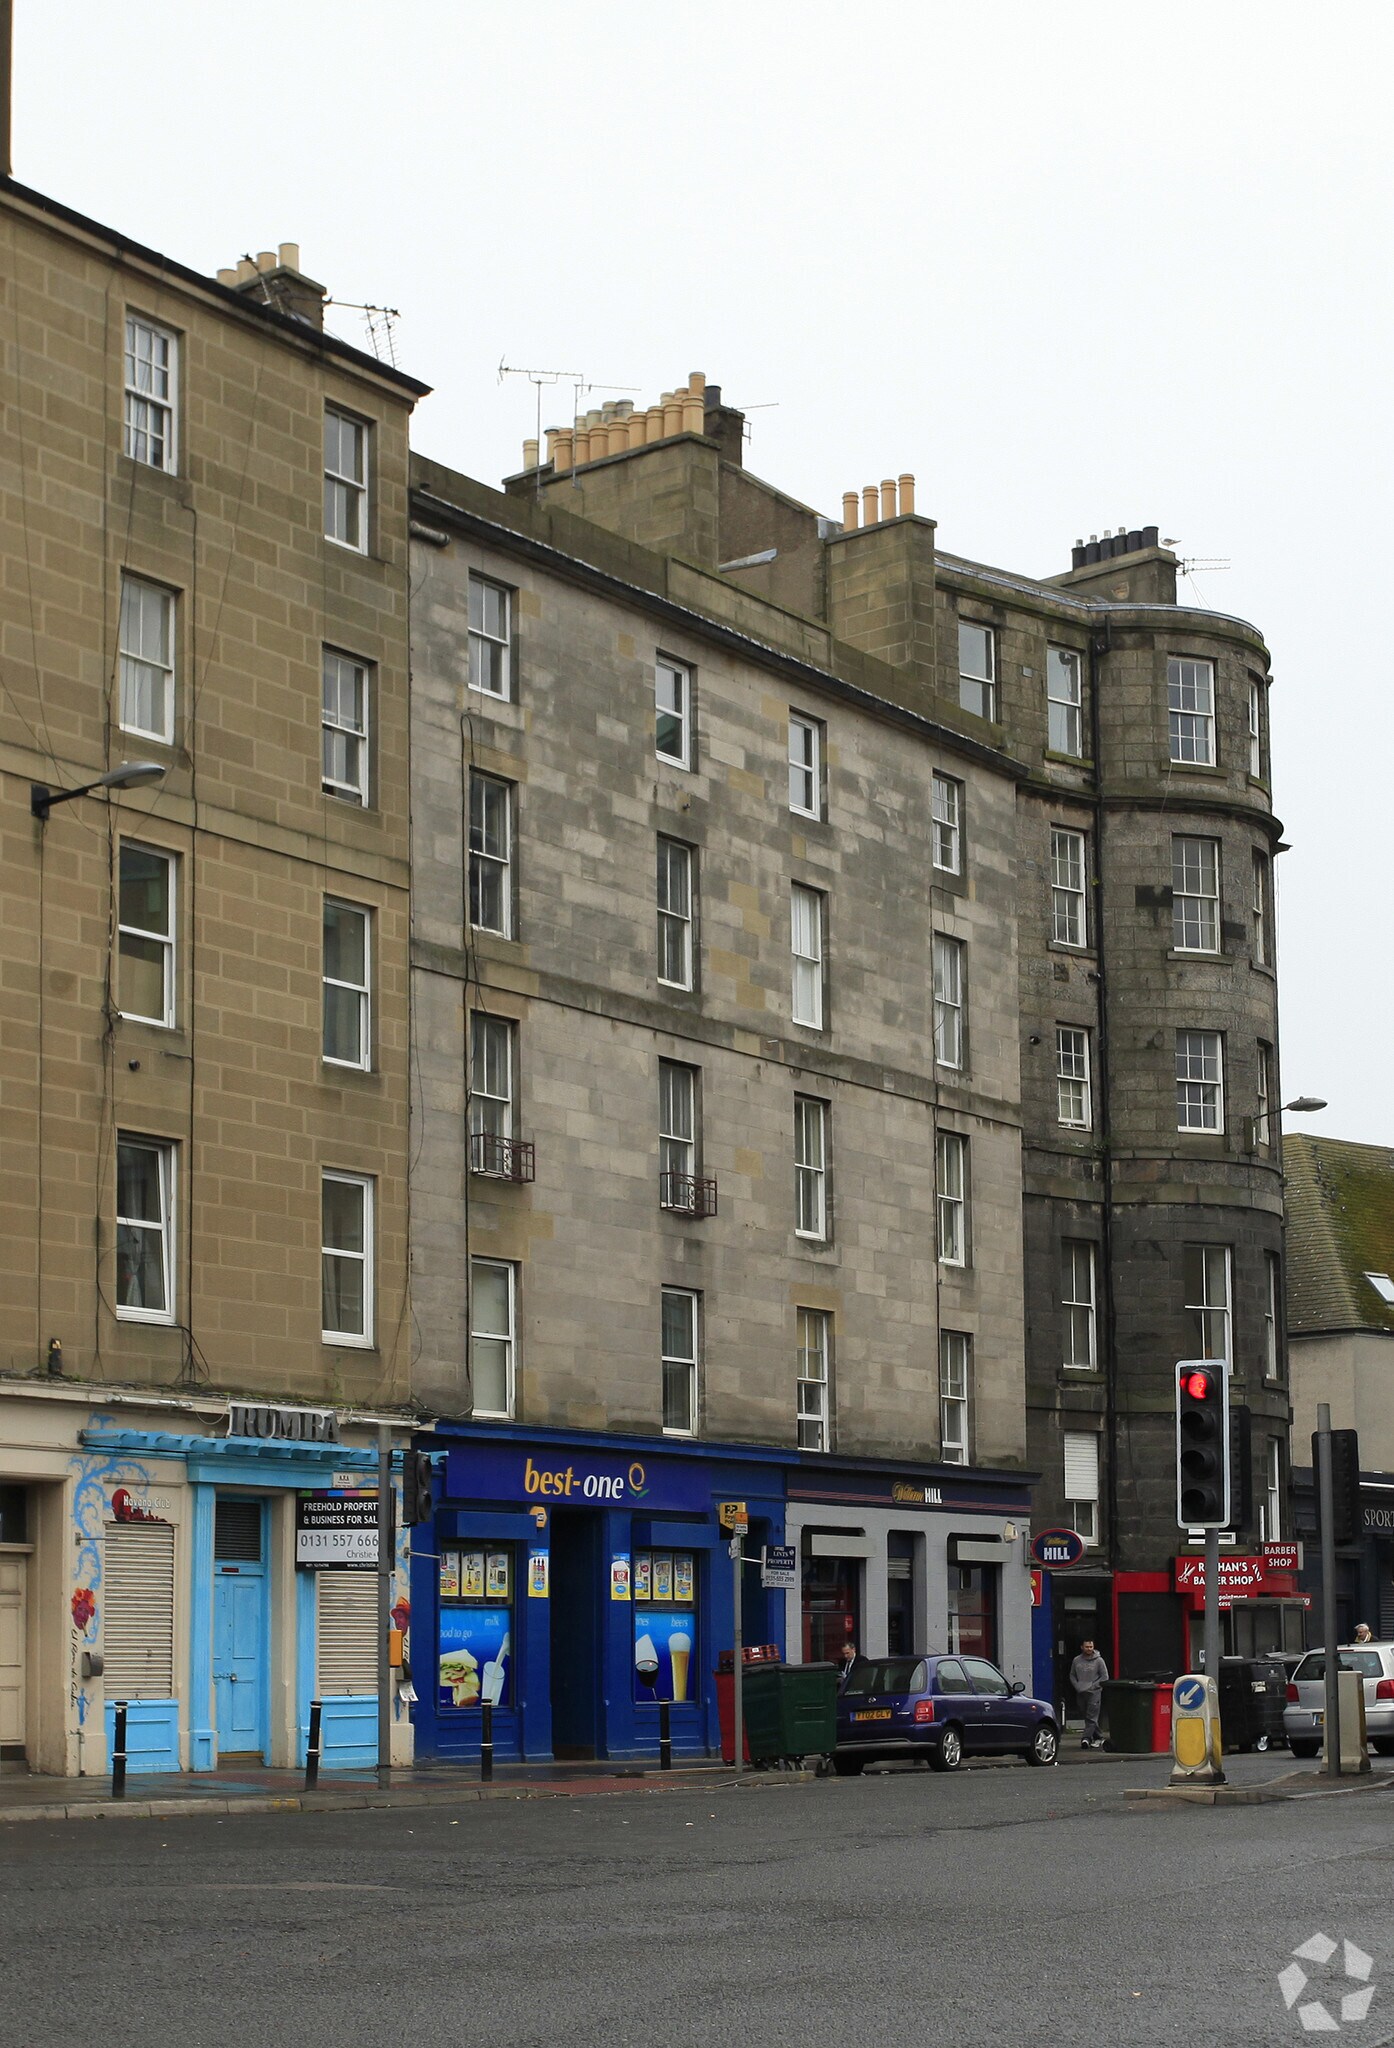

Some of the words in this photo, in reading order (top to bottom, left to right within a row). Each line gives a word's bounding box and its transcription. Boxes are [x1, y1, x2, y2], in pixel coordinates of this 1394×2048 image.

[231, 1406, 341, 1442] RUMBA
[924, 1487, 943, 1504] HILL
[123, 1495, 152, 1507] Havana
[303, 1502, 342, 1512] FREEHOLD
[343, 1502, 380, 1511] PROPERT
[303, 1516, 310, 1525] &
[311, 1516, 345, 1525] BUSINESS
[346, 1516, 362, 1524] FOR
[363, 1515, 379, 1524] SAL
[300, 1534, 328, 1547] 0131
[332, 1534, 353, 1547] 557
[357, 1534, 379, 1547] 666
[346, 1550, 373, 1559] Christie
[1043, 1547, 1071, 1560] HILL
[1264, 1546, 1297, 1555] BARBER
[1268, 1558, 1293, 1567] SHOP
[1228, 1575, 1254, 1585] SHOP
[671, 1617, 689, 1627] beers
